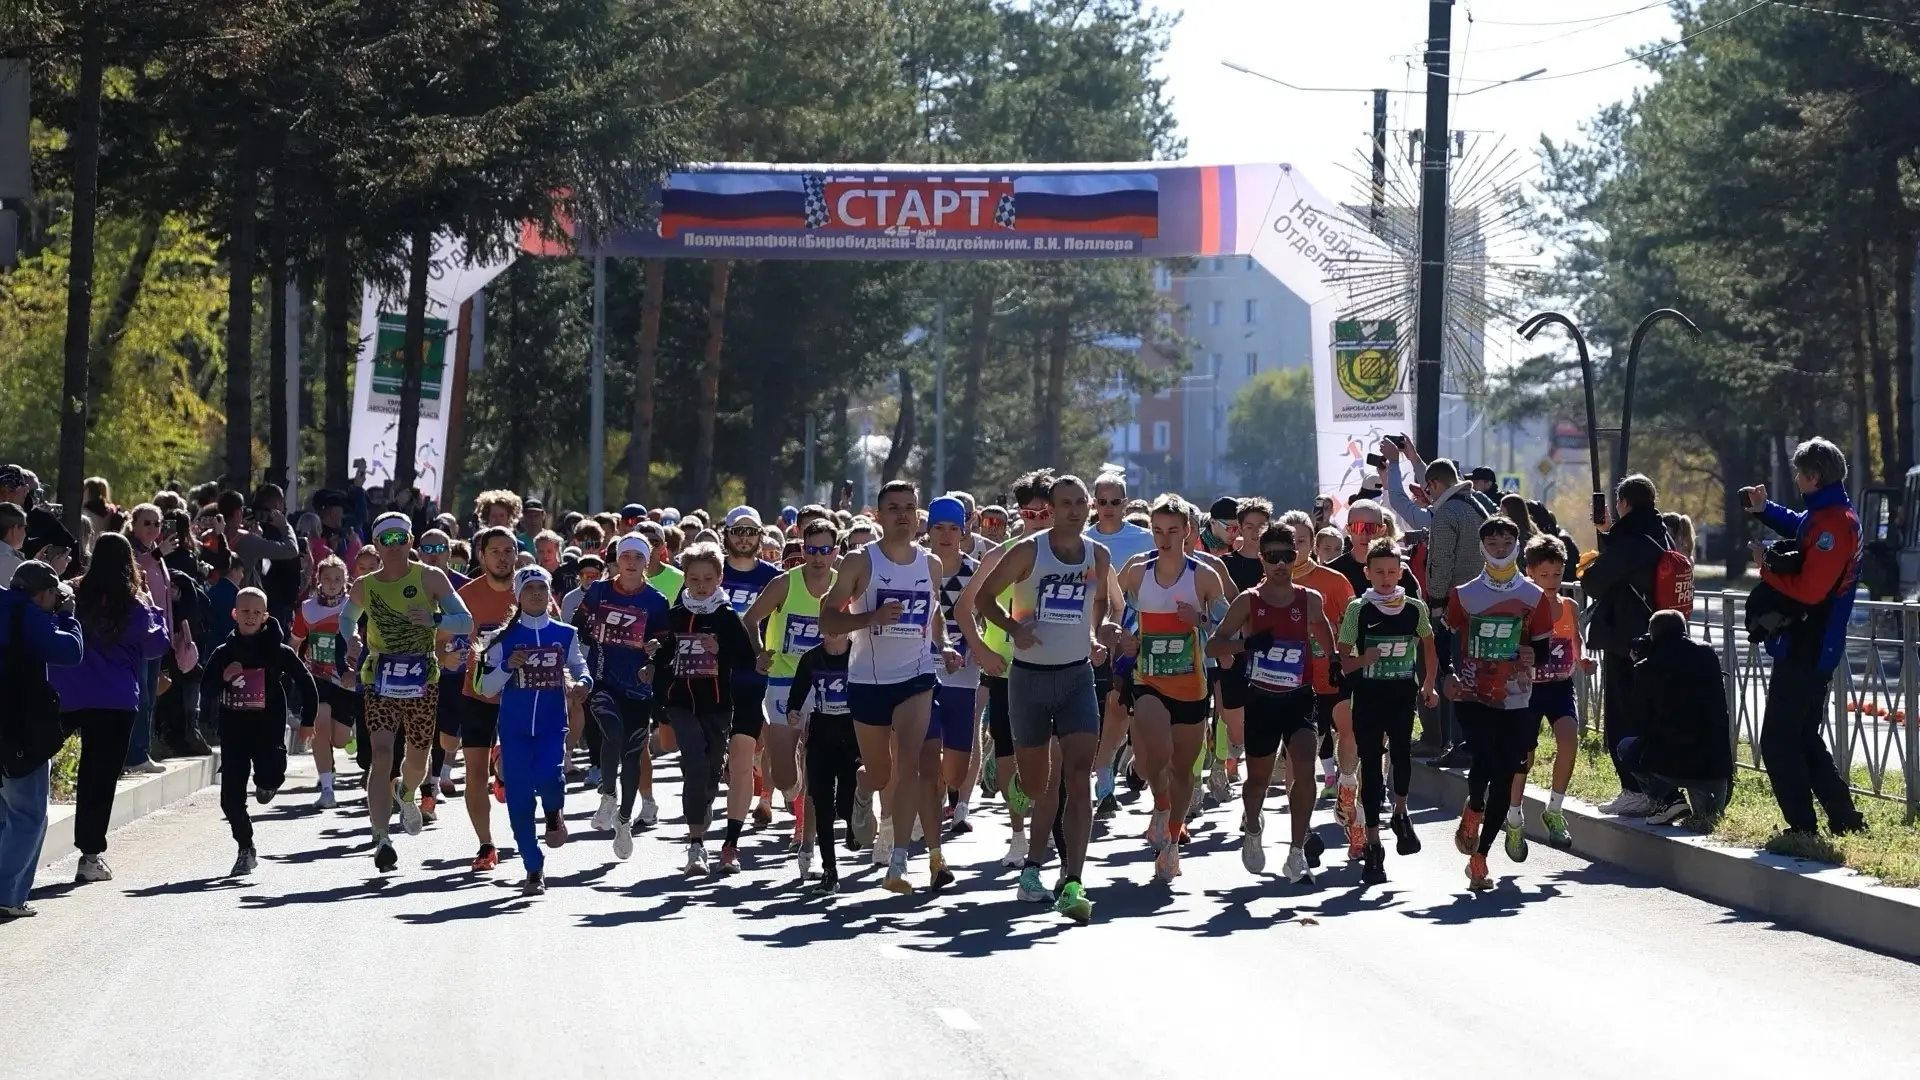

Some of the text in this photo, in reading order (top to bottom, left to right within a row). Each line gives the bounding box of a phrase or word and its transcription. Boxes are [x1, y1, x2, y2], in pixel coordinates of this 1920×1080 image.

[837, 188, 989, 227] СТАРТ
[684, 232, 799, 249] Полумарафон
[1004, 239, 1031, 250] им.
[1064, 236, 1134, 251] Пеллера
[1042, 583, 1085, 600] 191
[606, 611, 637, 628] 67
[1479, 622, 1513, 639] 86
[1151, 639, 1184, 654] 89
[525, 652, 558, 668] 43
[382, 662, 423, 677] 154
[231, 675, 246, 689] 4
